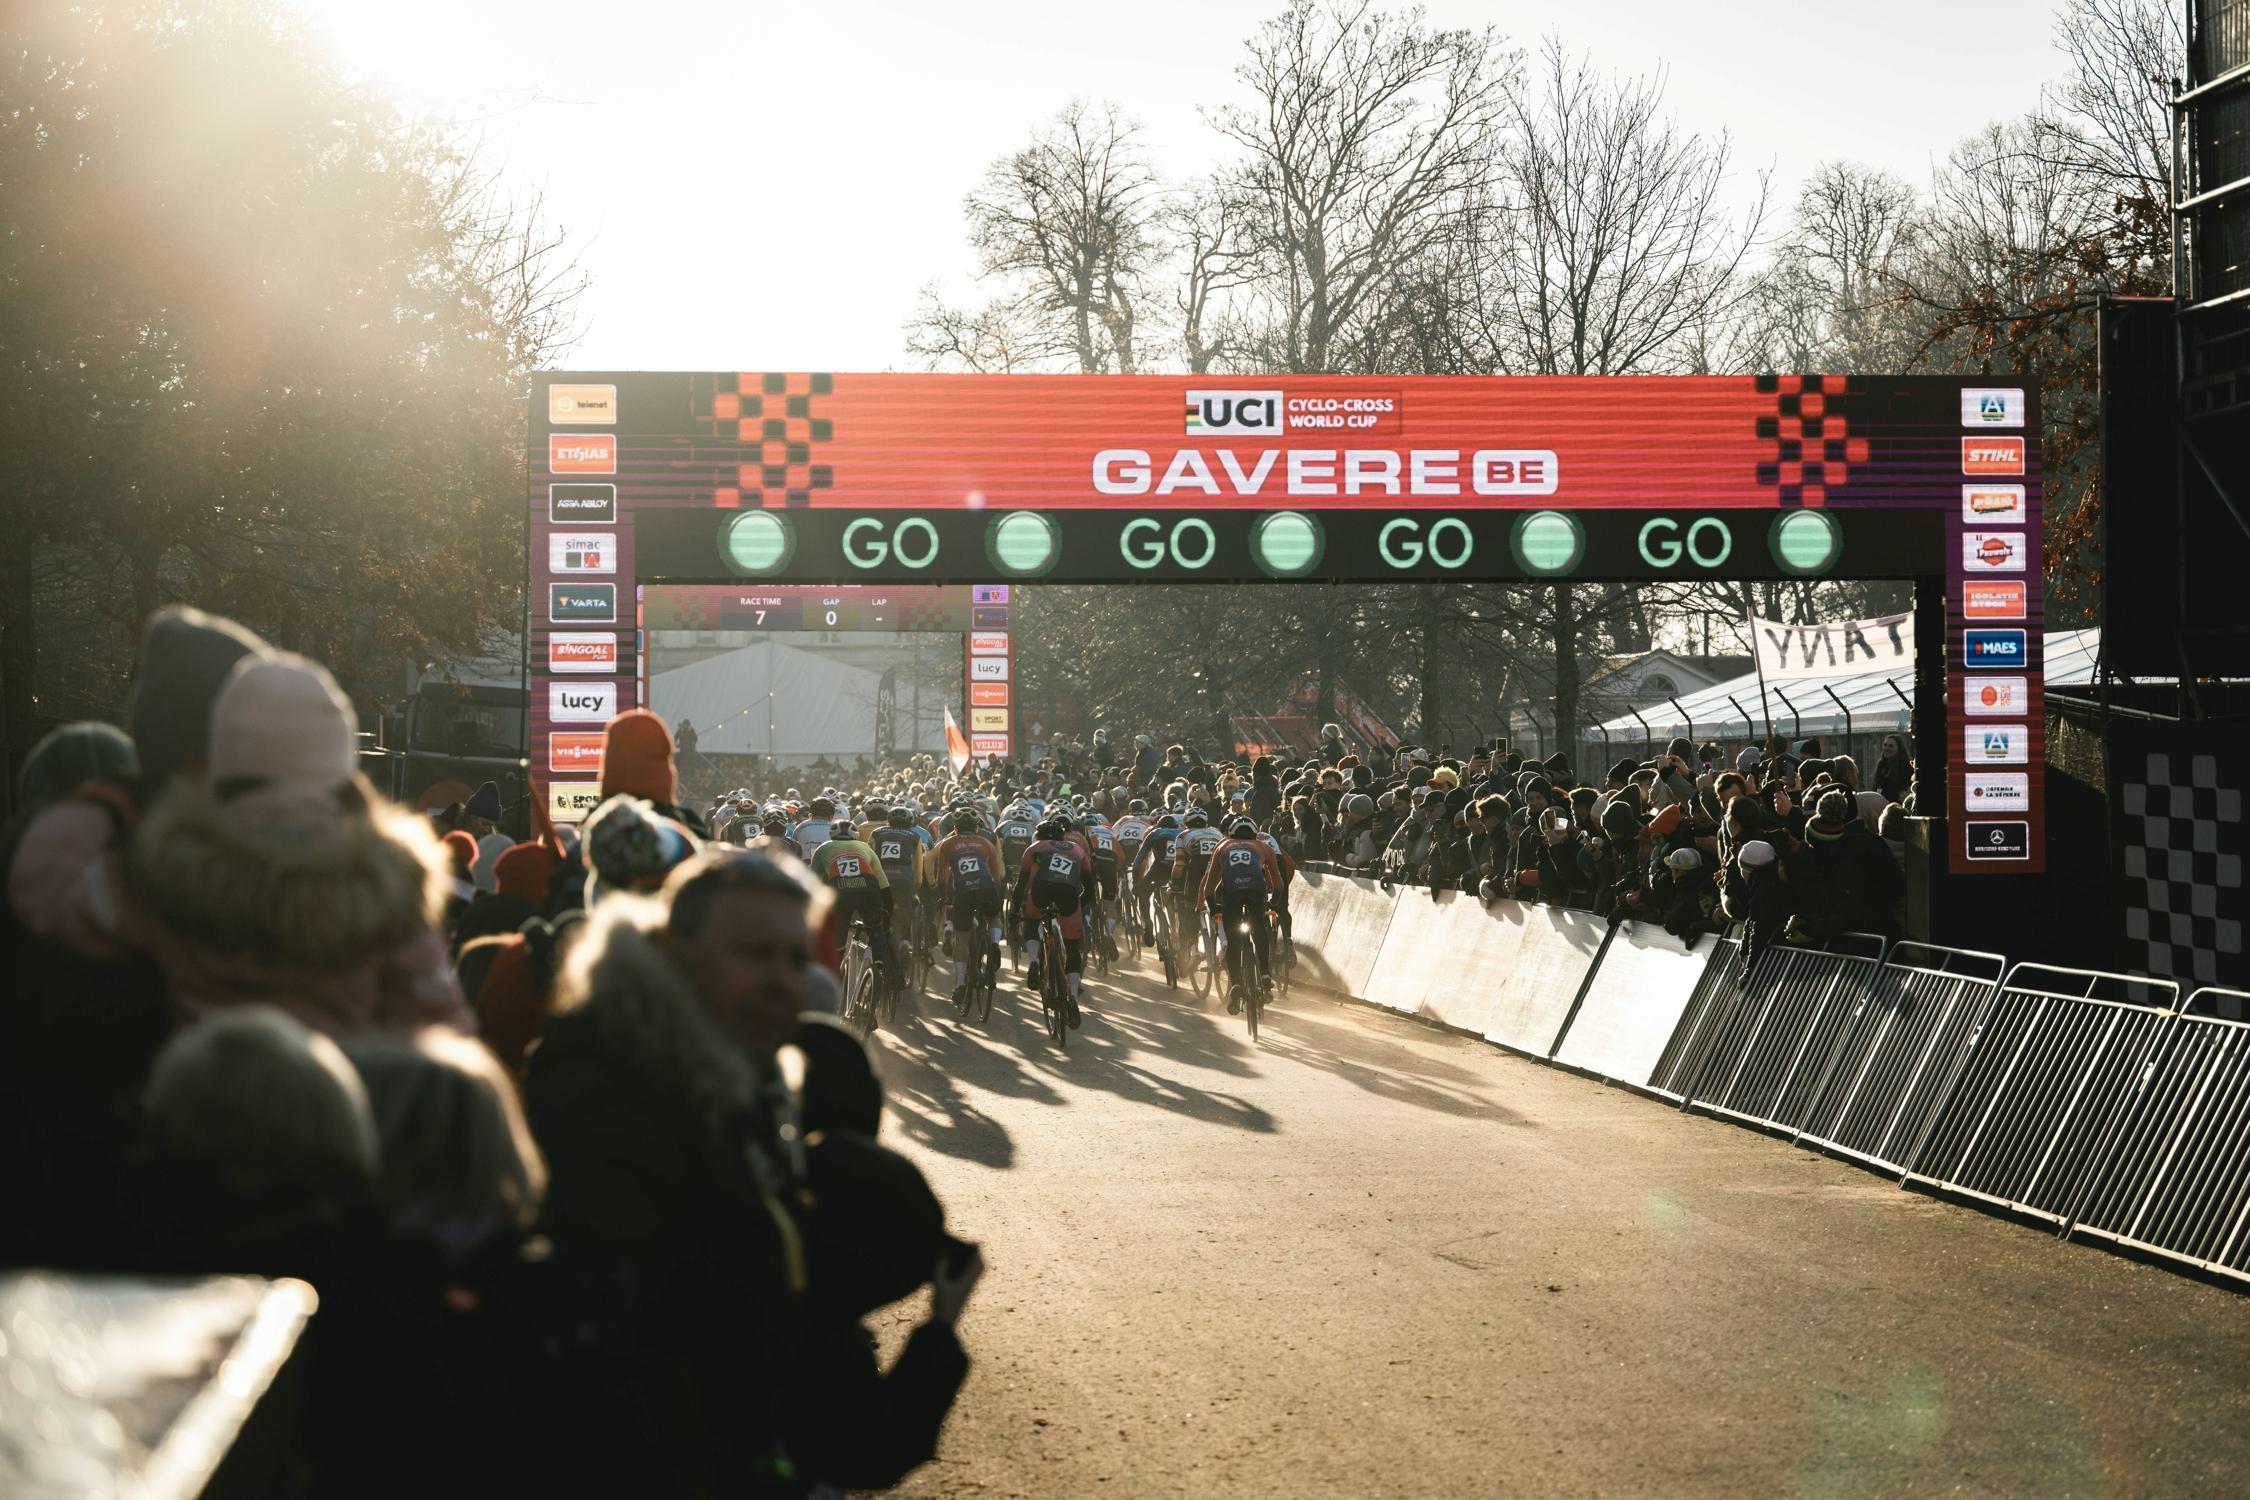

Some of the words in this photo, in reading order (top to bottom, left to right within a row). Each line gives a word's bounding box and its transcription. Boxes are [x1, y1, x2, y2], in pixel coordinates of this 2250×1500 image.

[576, 400, 608, 409] telenet
[1288, 398, 1394, 412] CYCLO-CROSS
[1203, 398, 1275, 427] UCI
[1289, 415, 1345, 428] WORLD
[1347, 415, 1378, 428] CUP
[1968, 449, 2019, 462] STIHL
[1092, 449, 1461, 495] GAVERE
[1487, 461, 1545, 484] BE
[581, 499, 609, 508] ABLOY
[565, 539, 601, 550] simac
[842, 517, 939, 569] GO
[1120, 517, 1216, 569] GO
[1379, 517, 1474, 569] GO
[1638, 517, 1732, 568] GO
[570, 599, 608, 608] VARTA
[740, 597, 761, 606] RACE
[763, 597, 781, 606] TIME
[823, 598, 841, 606] GAP
[755, 610, 766, 625] 7
[825, 611, 837, 626] 0
[557, 643, 608, 655] BINGOAL
[1983, 642, 2017, 654] MAES
[978, 663, 1001, 674] lucy
[561, 692, 604, 712] lucy
[975, 741, 1003, 749] VELUX
[882, 844, 899, 856] 76
[1231, 852, 1250, 862] 68
[839, 861, 859, 874] 75
[960, 859, 977, 872] 67
[1052, 857, 1072, 871] 37
